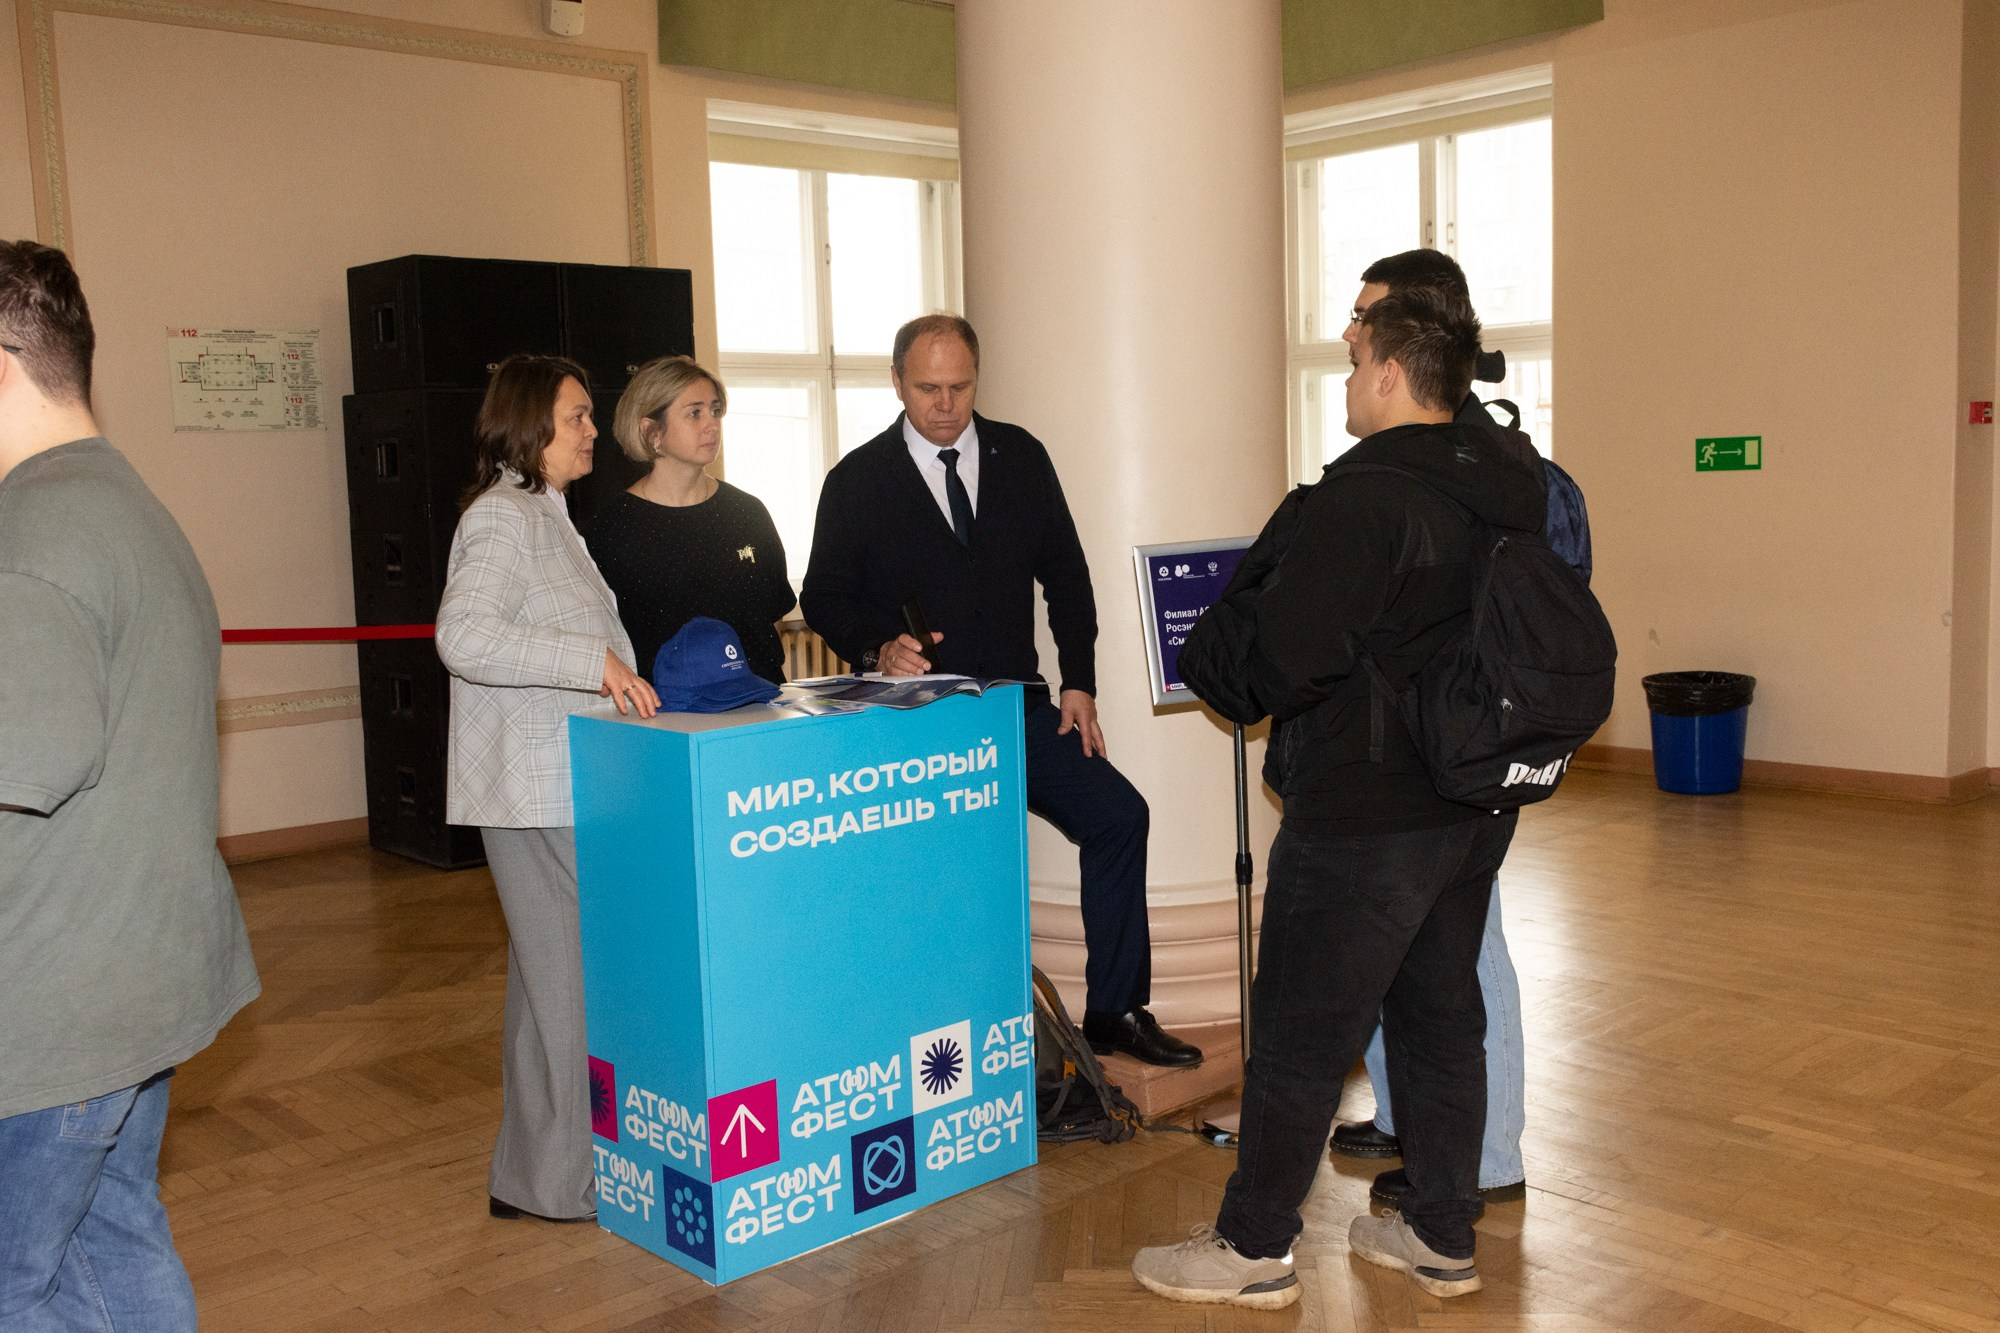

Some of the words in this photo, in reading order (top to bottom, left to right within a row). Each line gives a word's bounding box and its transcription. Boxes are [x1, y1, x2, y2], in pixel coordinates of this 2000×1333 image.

[180, 329, 197, 337] 112
[1164, 609, 1197, 620] Филиал
[1167, 636, 1188, 646] «См
[727, 777, 824, 818] МИР,
[829, 736, 998, 799] КОТОРЫЙ
[729, 797, 935, 859] СОЗДАЕШЬ
[942, 780, 1000, 815] ТЫ!
[981, 1040, 1035, 1076] ФЕ
[790, 1081, 902, 1140] ФЕСТ
[624, 1112, 708, 1169] ФЕСТ
[925, 1116, 1024, 1172] ФЕСТ
[725, 1182, 842, 1245] ФЕСТ
